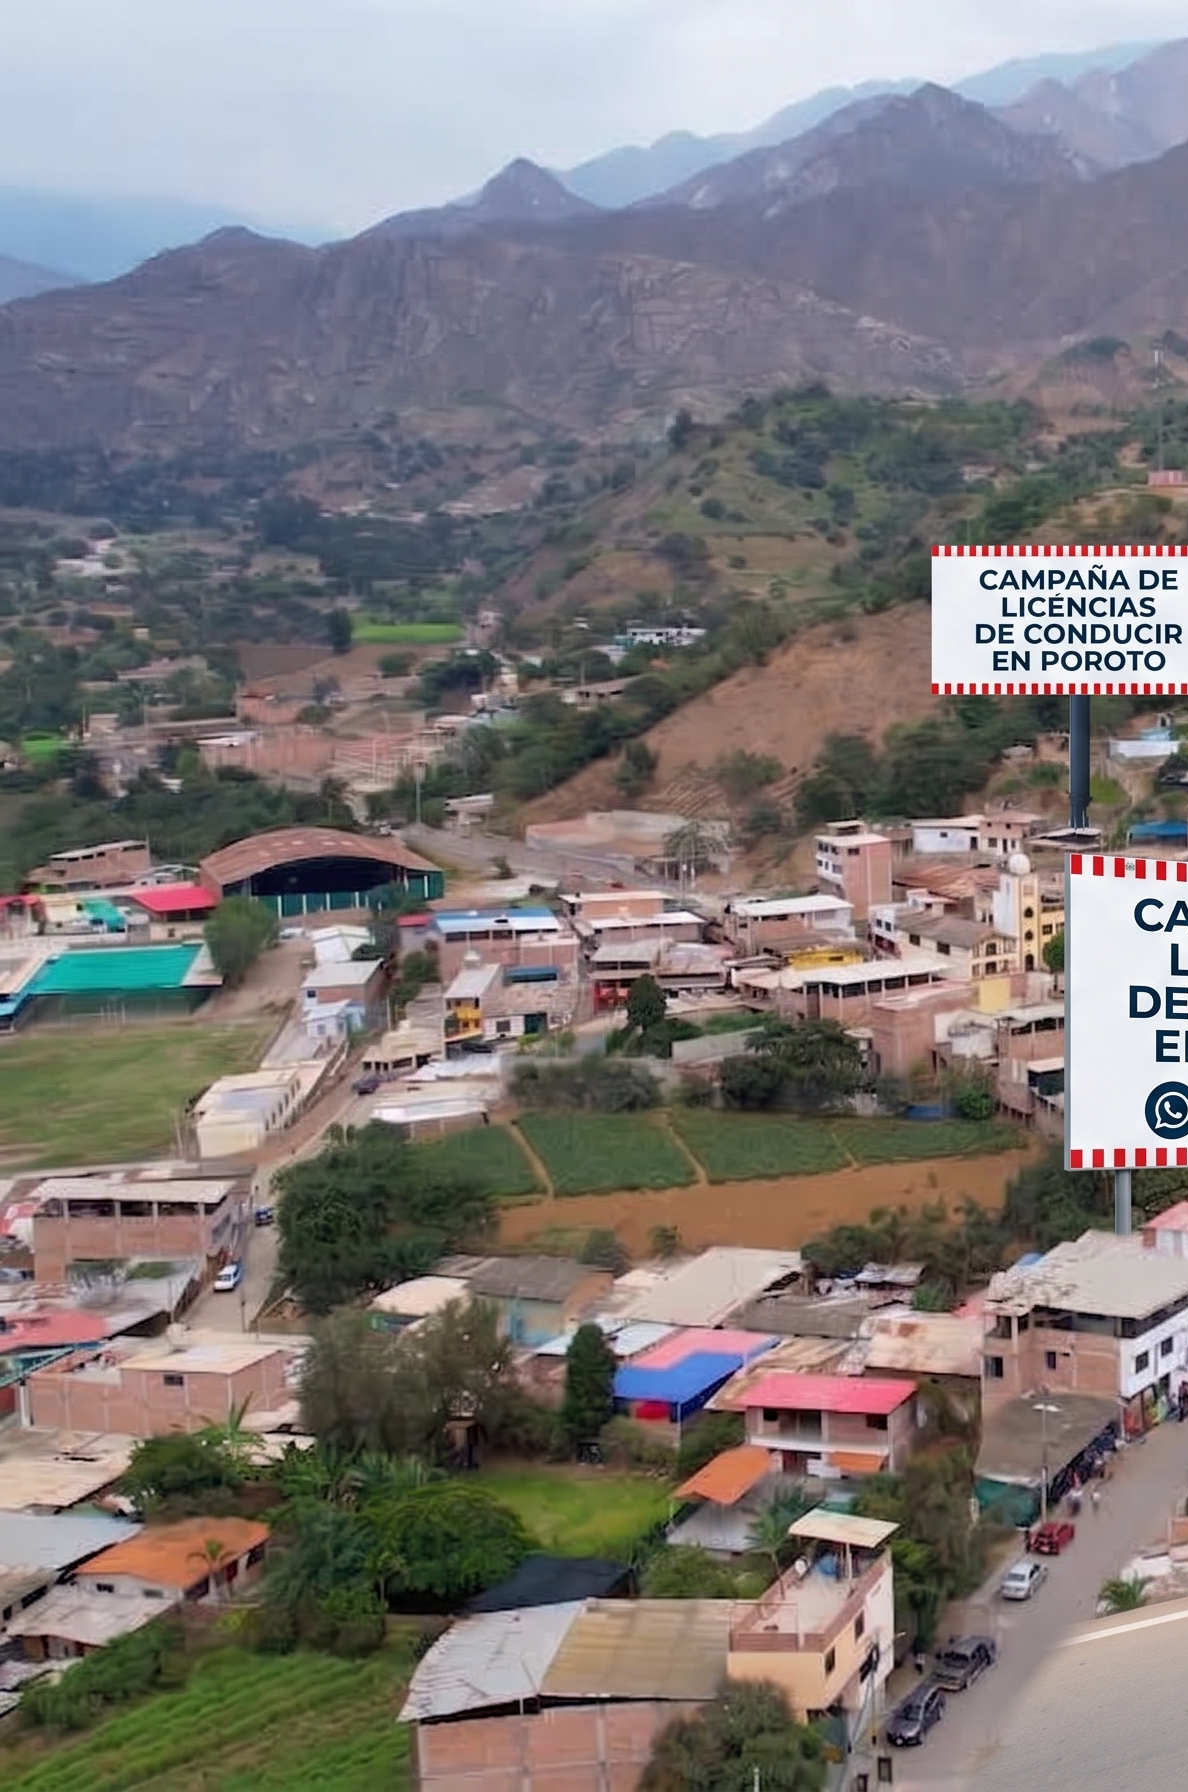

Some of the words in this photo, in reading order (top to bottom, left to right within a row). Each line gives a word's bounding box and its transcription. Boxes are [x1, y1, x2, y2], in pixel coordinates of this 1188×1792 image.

[979, 564, 1131, 591] CAMPAÑA
[1139, 569, 1179, 591] DE
[975, 623, 1015, 645] DE
[1023, 623, 1183, 645] CONDUCIR
[992, 650, 1031, 672] EN
[1041, 650, 1166, 672] POROTO
